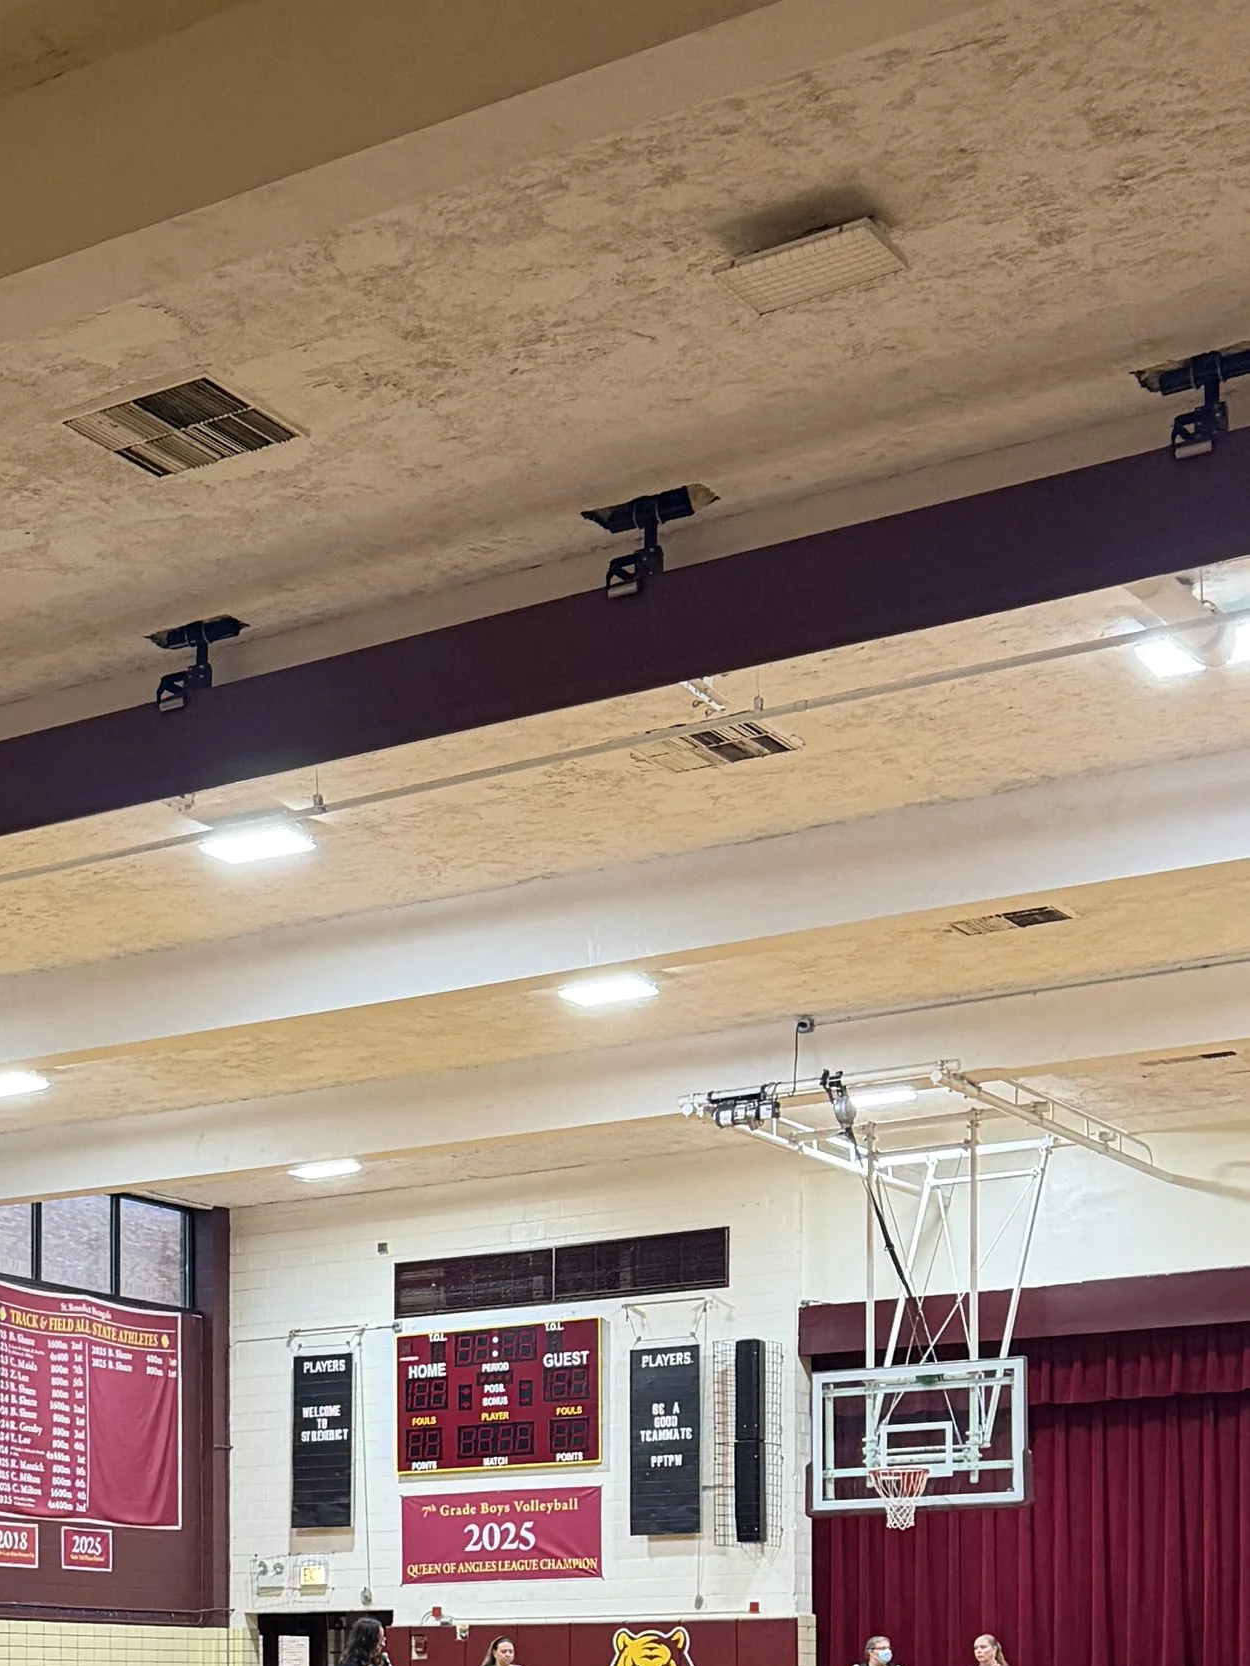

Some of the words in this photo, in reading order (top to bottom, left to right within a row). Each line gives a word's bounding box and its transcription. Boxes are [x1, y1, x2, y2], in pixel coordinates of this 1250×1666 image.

[10, 1309, 38, 1328] TRACK
[40, 1316, 48, 1330] &
[49, 1317, 74, 1332] FIELD
[75, 1318, 90, 1334] ALL
[92, 1322, 117, 1341] STATE
[118, 1330, 158, 1347] ATHLETES
[542, 1350, 590, 1368] GUEST
[303, 1360, 346, 1374] PLAYERS
[408, 1362, 447, 1378] HOME
[482, 1362, 510, 1373] PERIOD
[484, 1384, 506, 1394] POSS.
[482, 1396, 508, 1406] BONUS
[302, 1404, 341, 1418] WELCOME
[556, 1406, 582, 1416] FOULS
[652, 1403, 665, 1415] BE
[672, 1402, 680, 1414] A
[316, 1418, 328, 1429] TO
[412, 1416, 436, 1426] FOULS
[482, 1412, 510, 1422] PLAYER
[654, 1415, 678, 1428] GOOD
[640, 1427, 692, 1442] TEAMMATE
[482, 1456, 508, 1466] MATCH
[556, 1452, 584, 1462] POINTS
[412, 1460, 438, 1470] POINTS
[440, 1504, 476, 1516] Grade
[480, 1502, 510, 1516] Boys
[514, 1498, 578, 1515] Volleyball
[464, 1520, 536, 1552] 2025
[72, 1535, 102, 1556] 2025
[407, 1563, 442, 1578] QUEEN
[442, 1562, 457, 1574] OF
[458, 1560, 497, 1574] ANGLES
[498, 1558, 538, 1572] LEAGUE
[540, 1557, 598, 1570] CHAMPION
